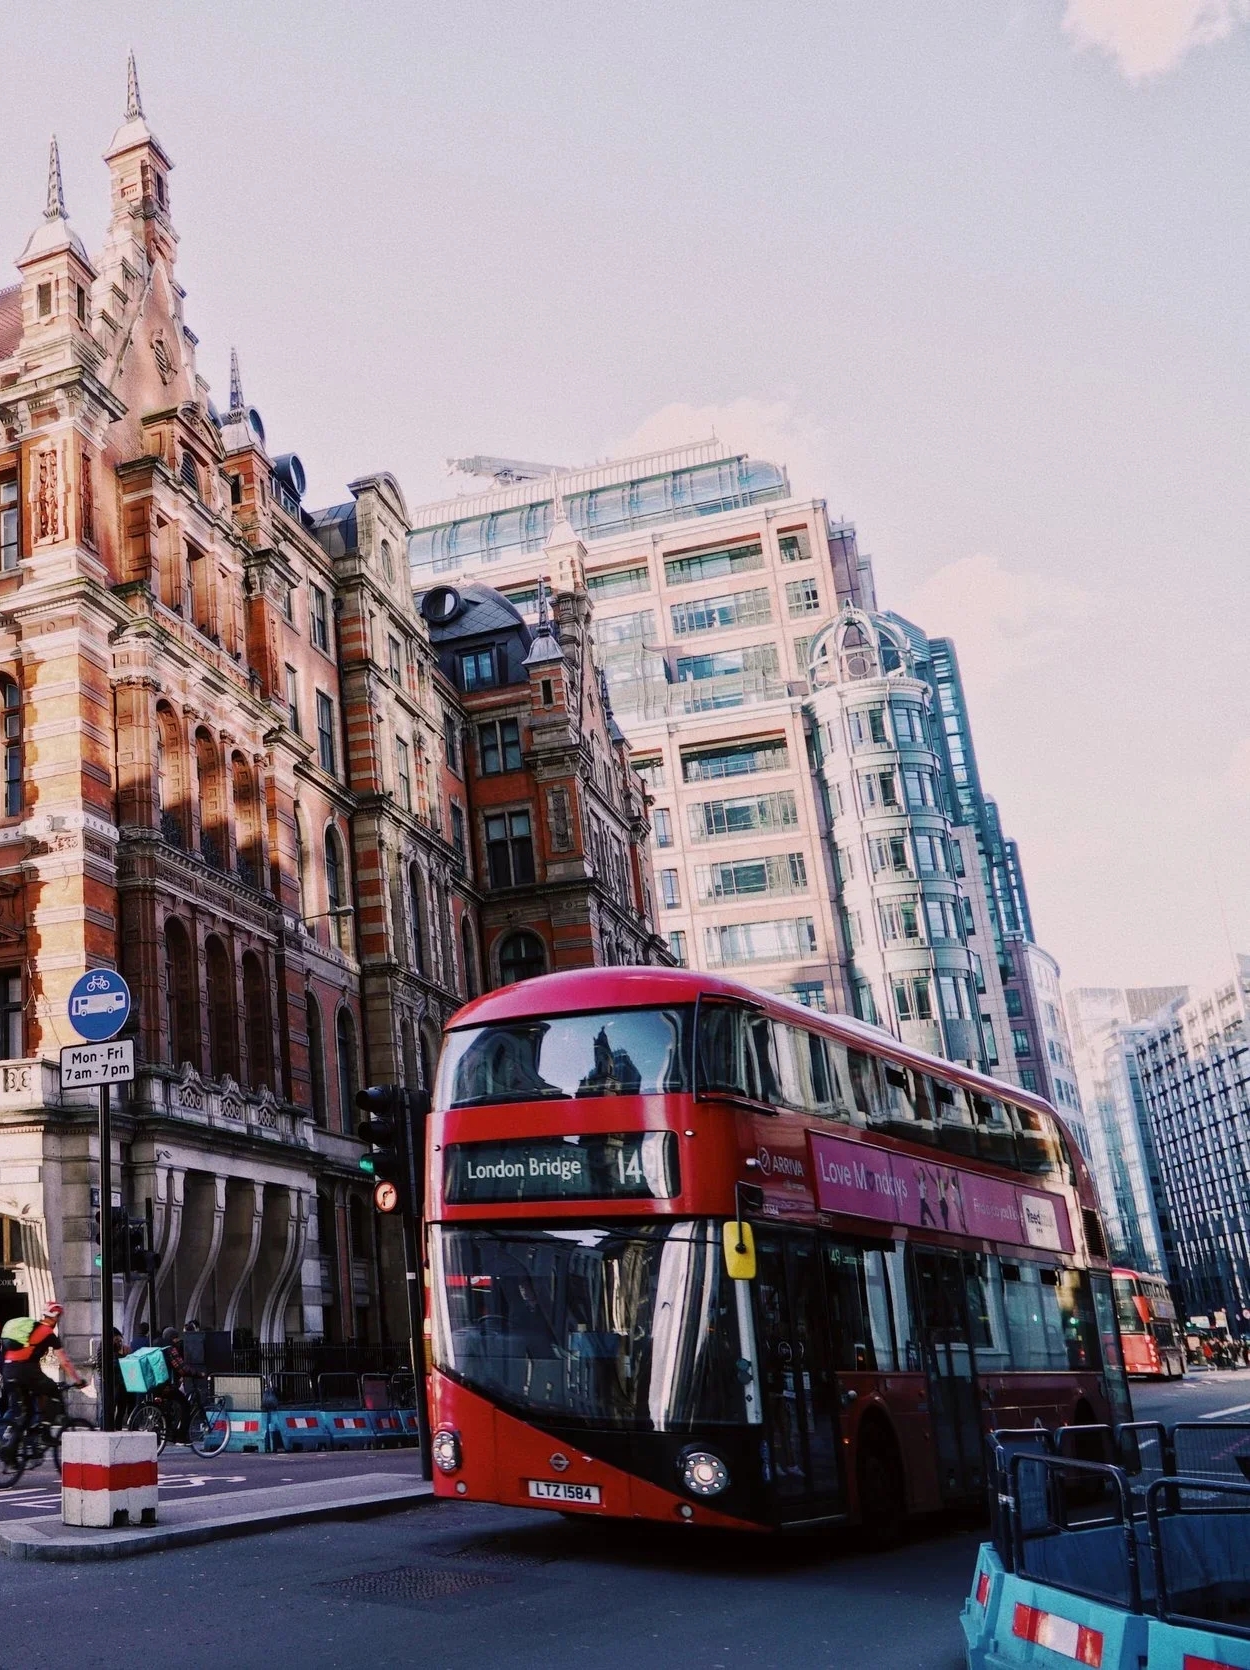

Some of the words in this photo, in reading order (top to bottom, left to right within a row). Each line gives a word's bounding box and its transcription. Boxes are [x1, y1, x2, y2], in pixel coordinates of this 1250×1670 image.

[72, 1052, 97, 1064] Mon
[107, 1046, 123, 1060] Fri
[467, 1157, 524, 1179] London
[529, 1156, 582, 1180] Bridge
[773, 1155, 804, 1177] ARRIVA
[819, 1151, 852, 1186] Love
